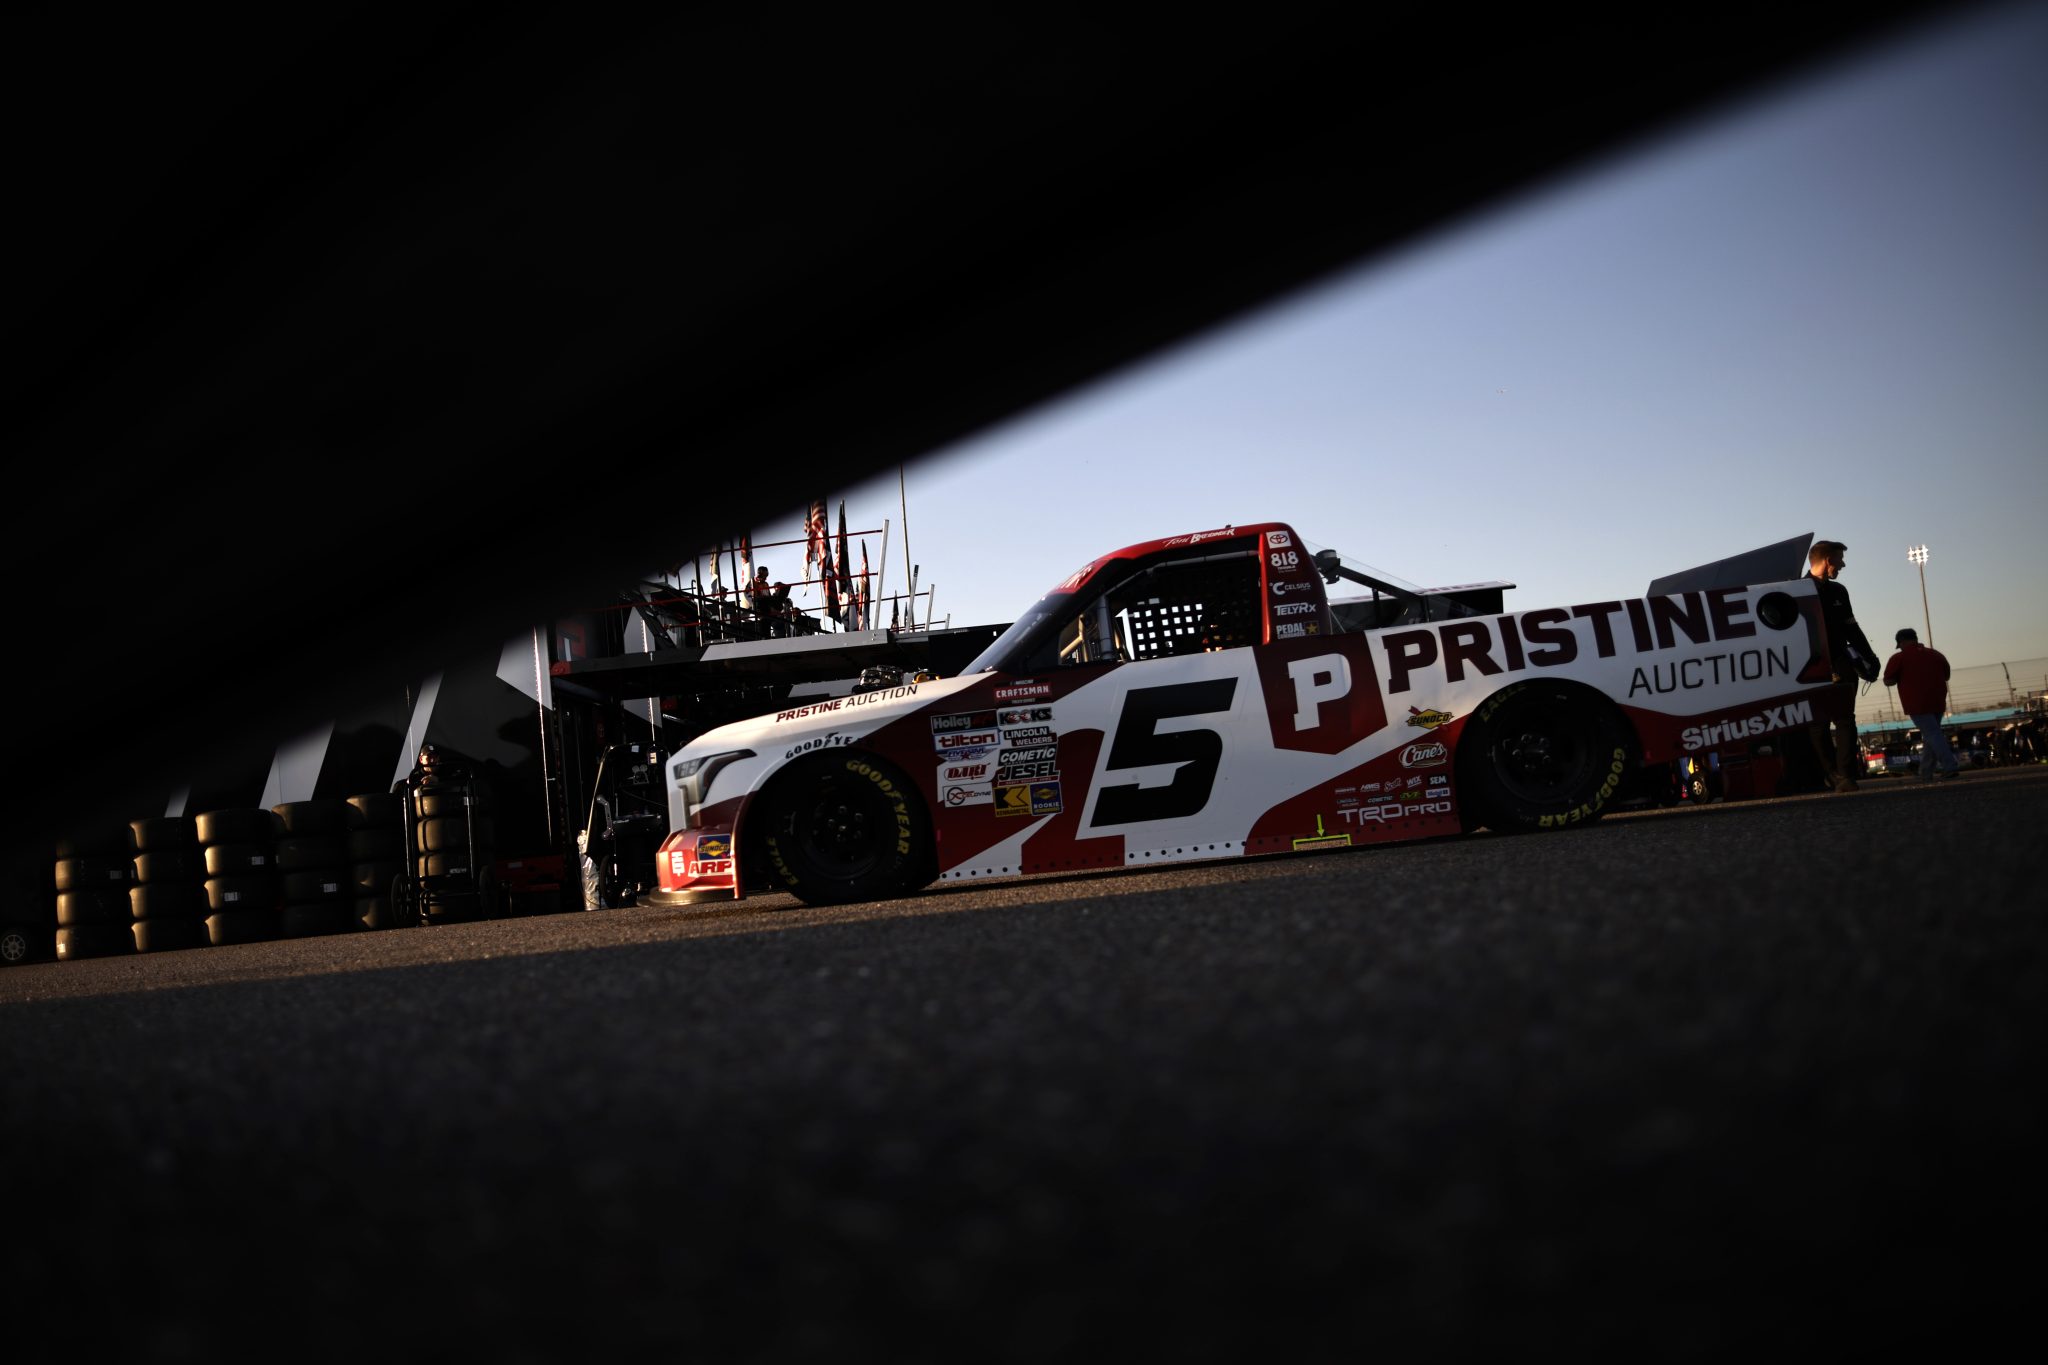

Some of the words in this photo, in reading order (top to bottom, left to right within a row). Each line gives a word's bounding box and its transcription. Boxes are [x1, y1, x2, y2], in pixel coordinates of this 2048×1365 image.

[1271, 551, 1299, 567] 818
[1276, 622, 1305, 634] PEDAL
[1384, 586, 1757, 694] PRISTINE
[1629, 646, 1789, 697] AUCTION
[996, 685, 1050, 698] CRAFTSMAN
[1288, 653, 1352, 732] P
[776, 700, 842, 722] PRISTINE
[845, 685, 919, 708] AUCTION
[933, 717, 971, 731] Holley
[1410, 713, 1450, 725] SUNOCO
[1681, 700, 1813, 751] SiriusXM
[939, 734, 995, 747] tilton
[1005, 728, 1047, 738] LINCOLN
[1000, 748, 1055, 763] COMETIC
[1090, 677, 1238, 827] 5
[1401, 742, 1446, 768] Cane's
[998, 762, 1058, 780] JESEL
[1429, 776, 1447, 785] SEM
[1537, 744, 1625, 828] GOODYEAR
[846, 760, 911, 856] GOODYEAR
[700, 844, 730, 852] SUNOCO
[689, 861, 733, 874] ARP
